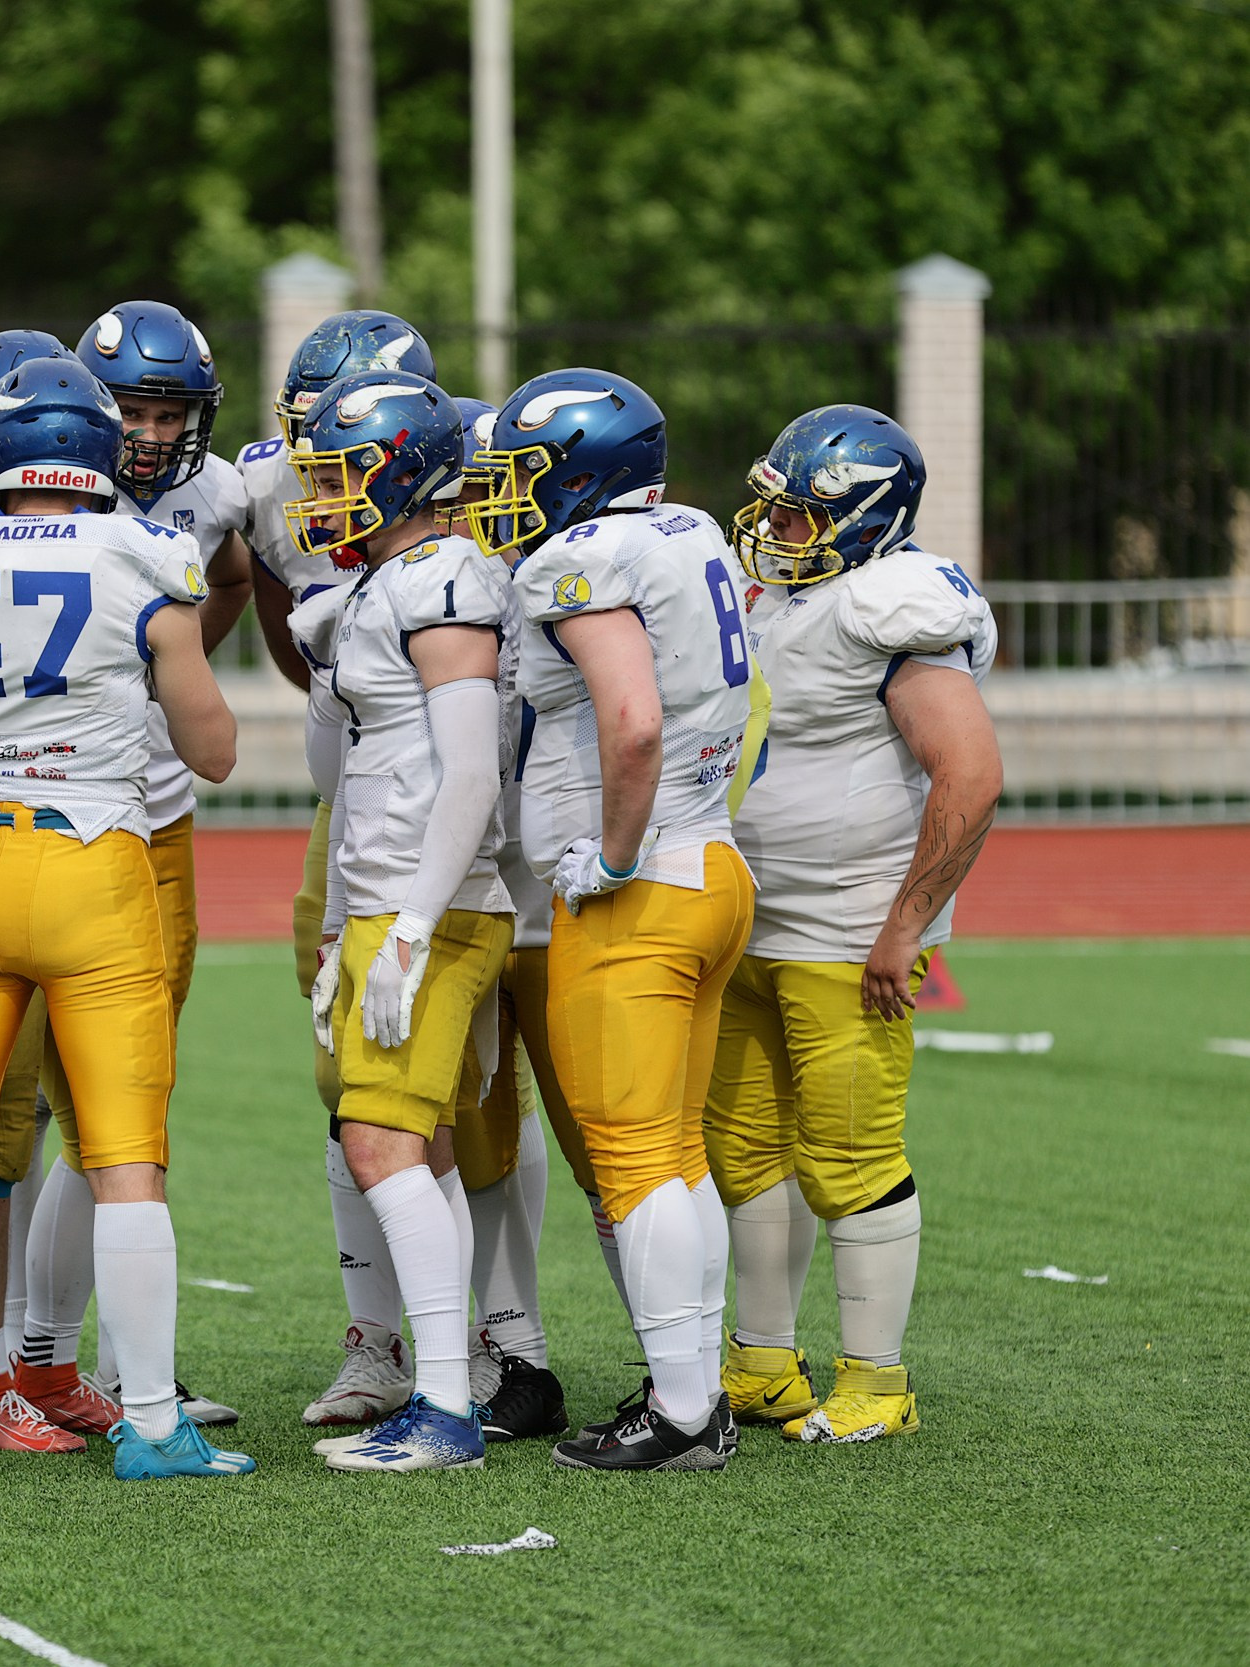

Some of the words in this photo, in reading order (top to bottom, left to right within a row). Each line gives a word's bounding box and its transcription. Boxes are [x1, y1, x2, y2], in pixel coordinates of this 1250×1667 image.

[22, 470, 97, 489] Riddell
[443, 580, 457, 618] 1
[705, 557, 749, 689] 8
[485, 1311, 526, 1325] MADRID
[488, 1308, 516, 1320] REAL
